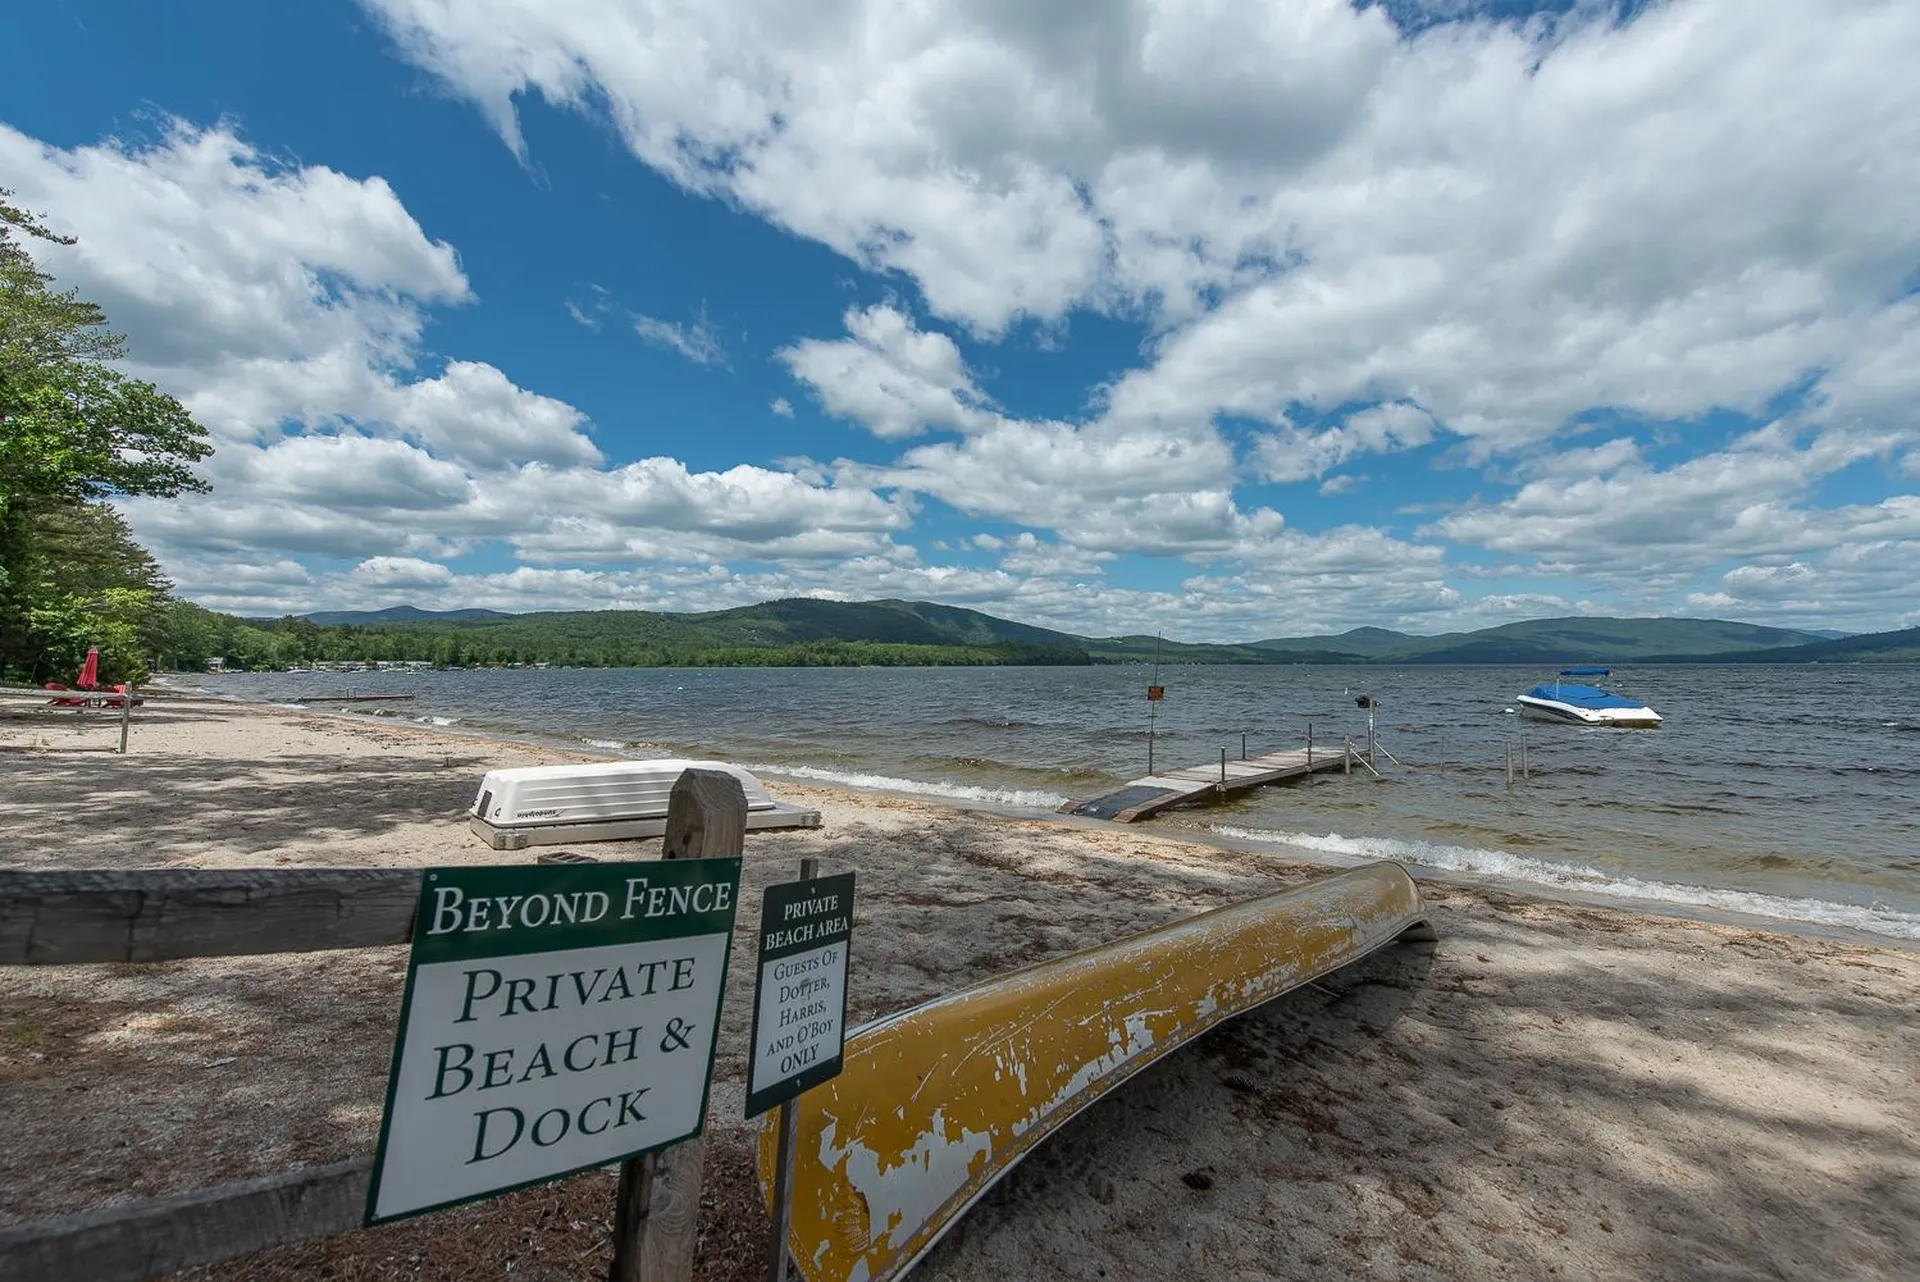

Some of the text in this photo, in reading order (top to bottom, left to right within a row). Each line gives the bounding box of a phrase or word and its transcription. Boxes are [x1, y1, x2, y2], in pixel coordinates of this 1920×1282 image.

[426, 877, 731, 935] BEYOND FENCE
[784, 895, 838, 920] PRIVATE
[764, 916, 848, 951] BEACH AREA
[774, 949, 839, 981] GUESTS OF
[453, 957, 696, 1024] PRIVATE
[779, 978, 830, 1004] DOTTER,
[779, 1001, 826, 1028] HARRIS,
[424, 1017, 696, 1101] BEACH &
[766, 1036, 794, 1056] AND
[780, 1043, 819, 1074] ONLY
[464, 1087, 651, 1165] DOCK
